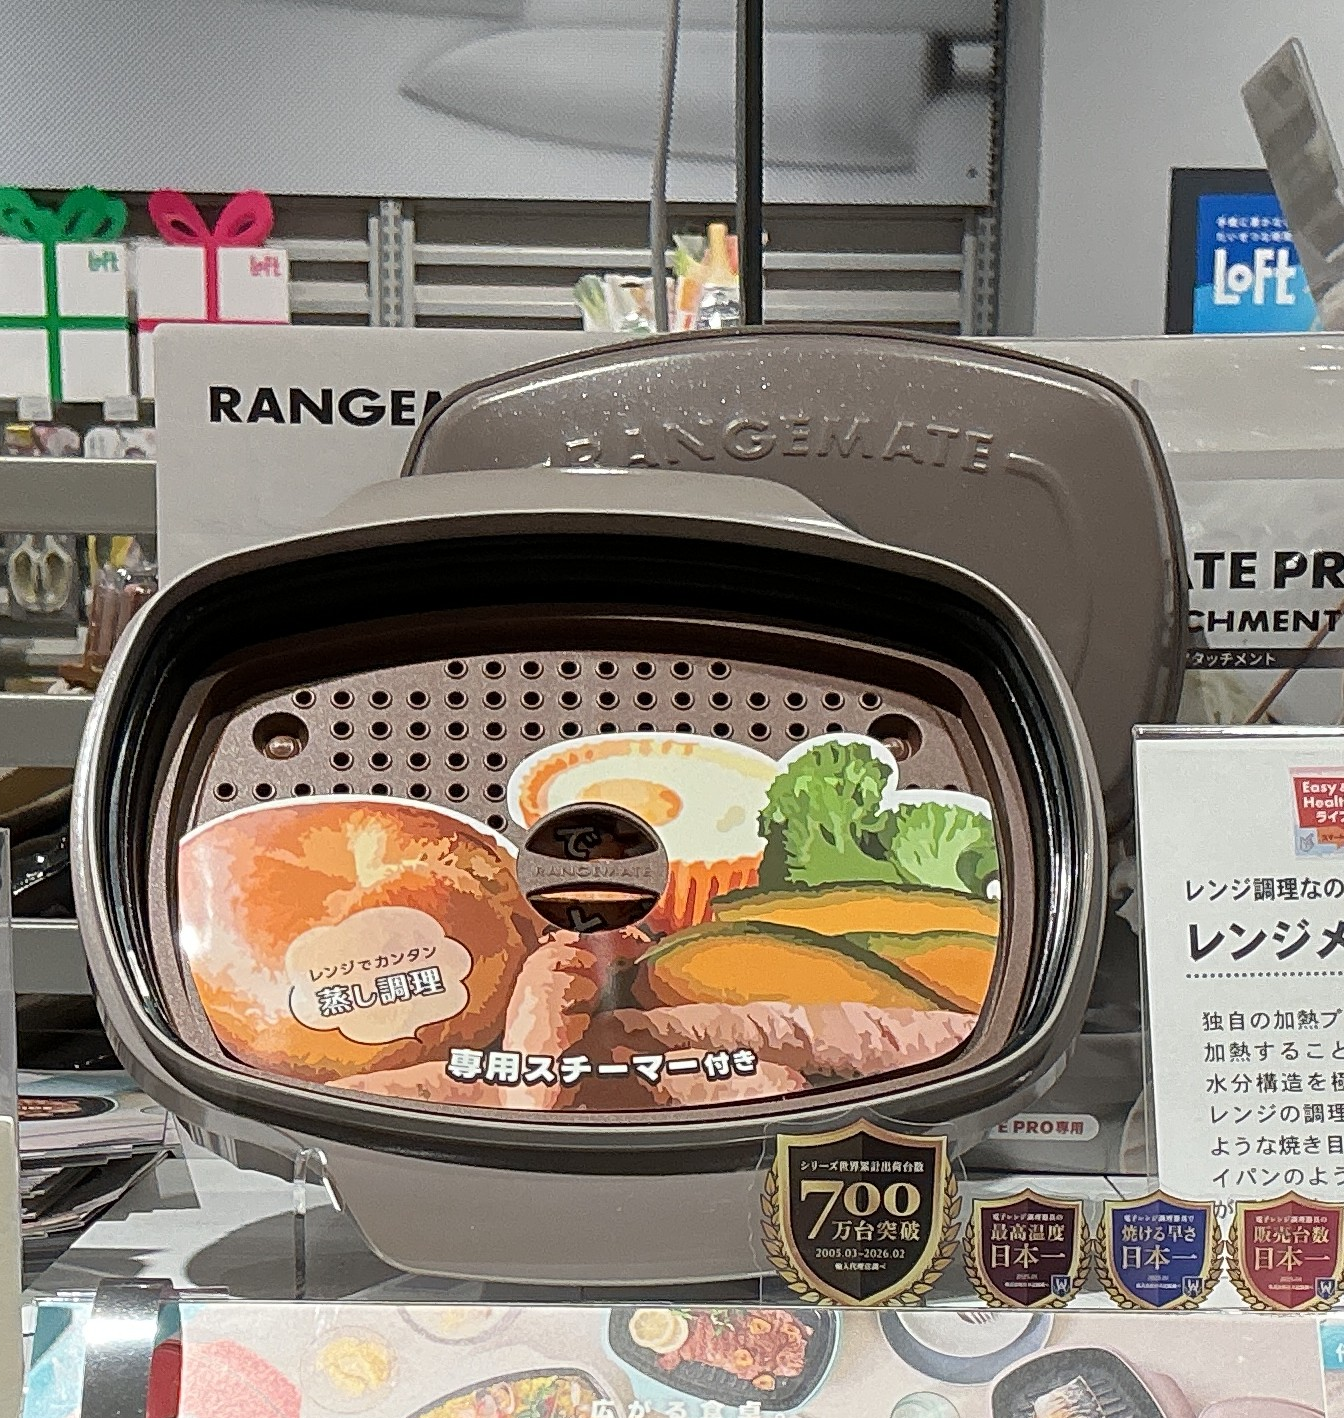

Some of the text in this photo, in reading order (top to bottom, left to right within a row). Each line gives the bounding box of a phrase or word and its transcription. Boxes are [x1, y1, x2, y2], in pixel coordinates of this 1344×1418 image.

[1302, 782, 1337, 797] Easy
[309, 944, 438, 983] レンジでカンタン
[316, 965, 446, 1018] 蒸し調理
[445, 1047, 759, 1086] 専用スチーマー付き
[801, 1180, 921, 1240] 700
[832, 1220, 920, 1242] 万台突破
[991, 1223, 1065, 1242] 最高温度
[1122, 1224, 1197, 1243] 焼ける早さ
[1253, 1226, 1330, 1244] 販売台数
[991, 1243, 1066, 1269] 日本一
[1122, 1244, 1198, 1270] 日本一
[1254, 1246, 1330, 1272] 日本一
